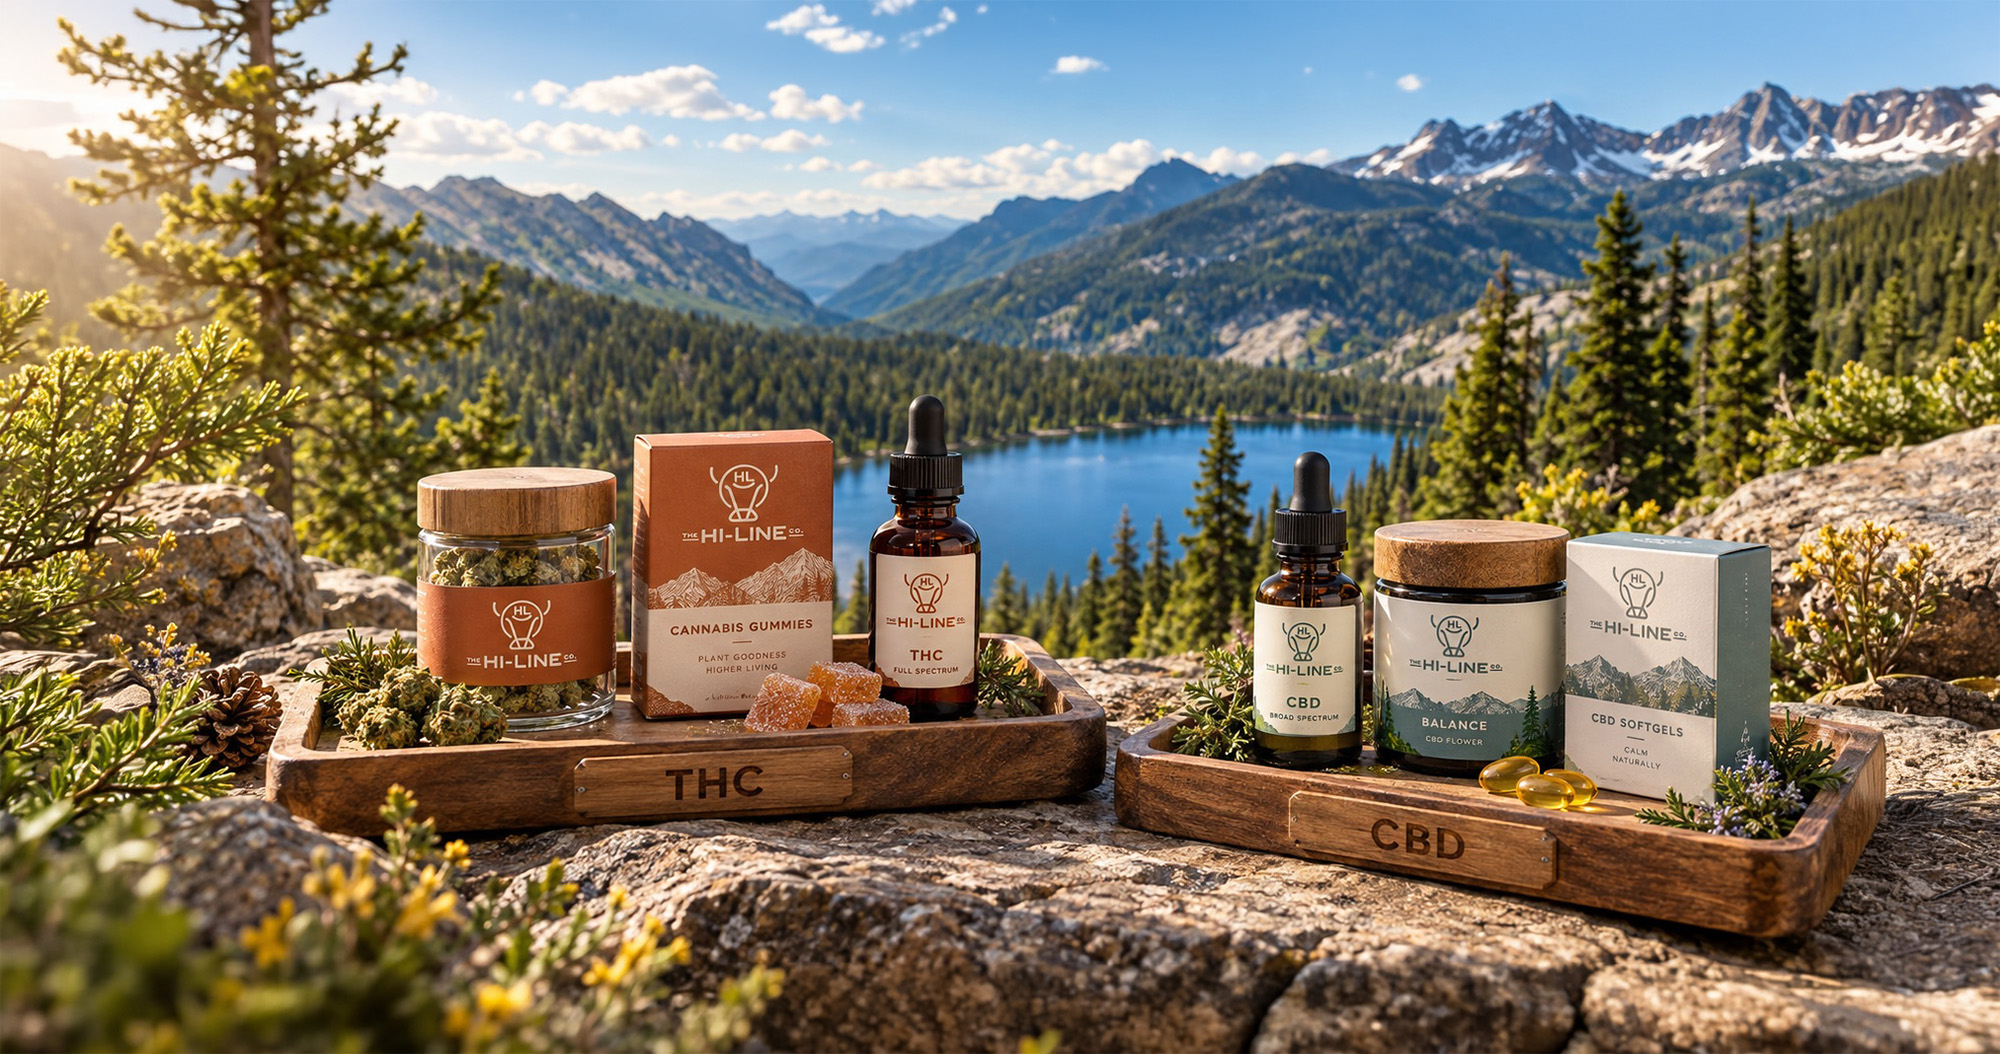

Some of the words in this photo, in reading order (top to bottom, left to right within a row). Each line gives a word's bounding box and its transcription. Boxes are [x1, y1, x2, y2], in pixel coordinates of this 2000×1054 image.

[734, 471, 755, 483] HL
[701, 525, 787, 544] HI-LINE
[920, 577, 934, 586] HL
[1631, 573, 1646, 584] HL
[513, 606, 531, 616] HL
[670, 622, 744, 636] CANNABIS
[749, 619, 813, 632] GUMMIES
[898, 617, 956, 628] HI-LINE
[1447, 620, 1462, 629] HL
[1297, 627, 1310, 636] HL
[1604, 620, 1672, 641] HI-LINE
[484, 653, 562, 668] HI-LINE
[698, 653, 730, 663] PLANT
[733, 651, 787, 661] GOODNESS
[910, 649, 943, 661] THC
[706, 664, 742, 674] HIGHER
[746, 663, 778, 672] LIVING
[893, 666, 913, 674] FULL
[915, 666, 959, 675] SPECTRUM
[1276, 664, 1332, 676] HI-LINE
[1422, 659, 1489, 674] HI-LINE
[1286, 696, 1321, 709] CBD
[1269, 712, 1294, 721] BROAD
[1297, 714, 1339, 722] SPECTRUM
[1422, 717, 1487, 731] BALANCE
[1591, 713, 1616, 726] CBD
[1620, 717, 1684, 737] SOFTGELS
[1425, 735, 1443, 744] CBD
[1446, 737, 1483, 746] FLOWER
[1624, 746, 1648, 756] CALM
[1612, 755, 1661, 770] NATURALLY
[665, 765, 764, 801] THC
[1370, 818, 1465, 860] CBD
